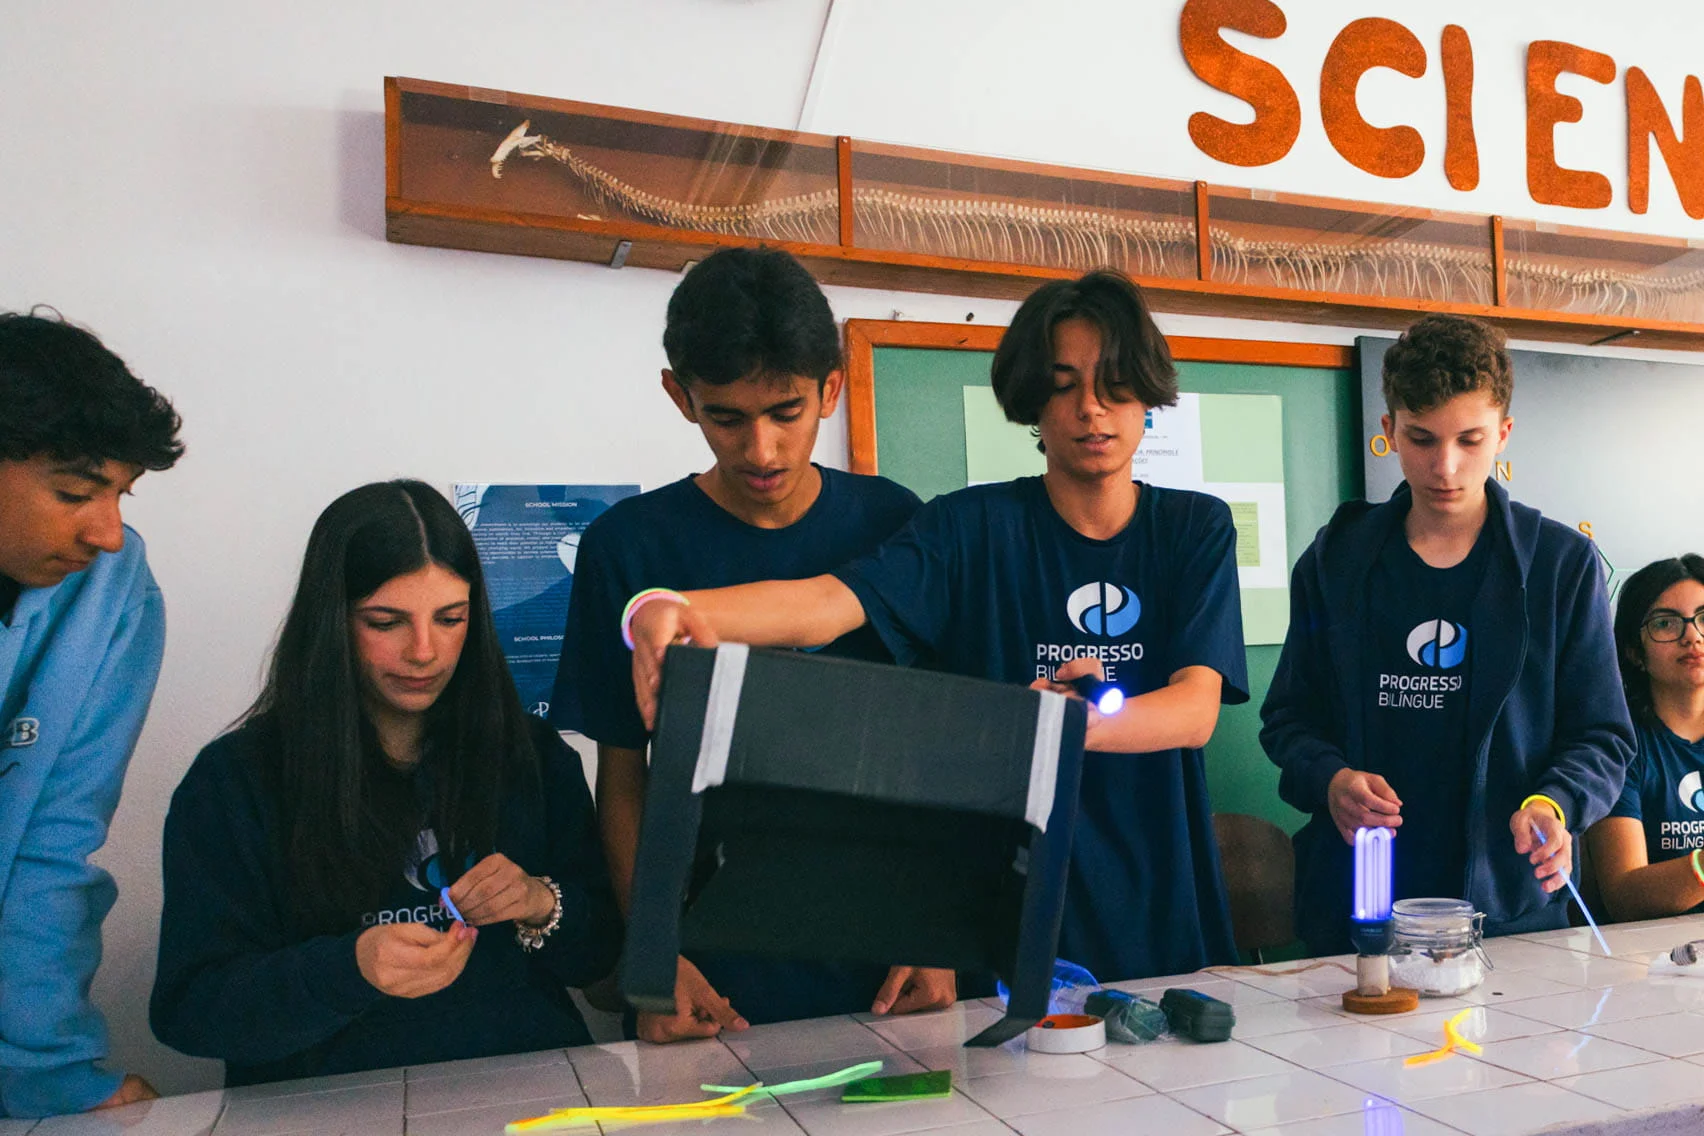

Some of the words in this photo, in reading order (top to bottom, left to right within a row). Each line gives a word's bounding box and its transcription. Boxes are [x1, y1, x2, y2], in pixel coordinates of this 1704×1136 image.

[1180, 0, 1704, 220] SCIEN
[1036, 643, 1144, 662] PROGRESSO
[1378, 691, 1445, 709] BILÍNGUE
